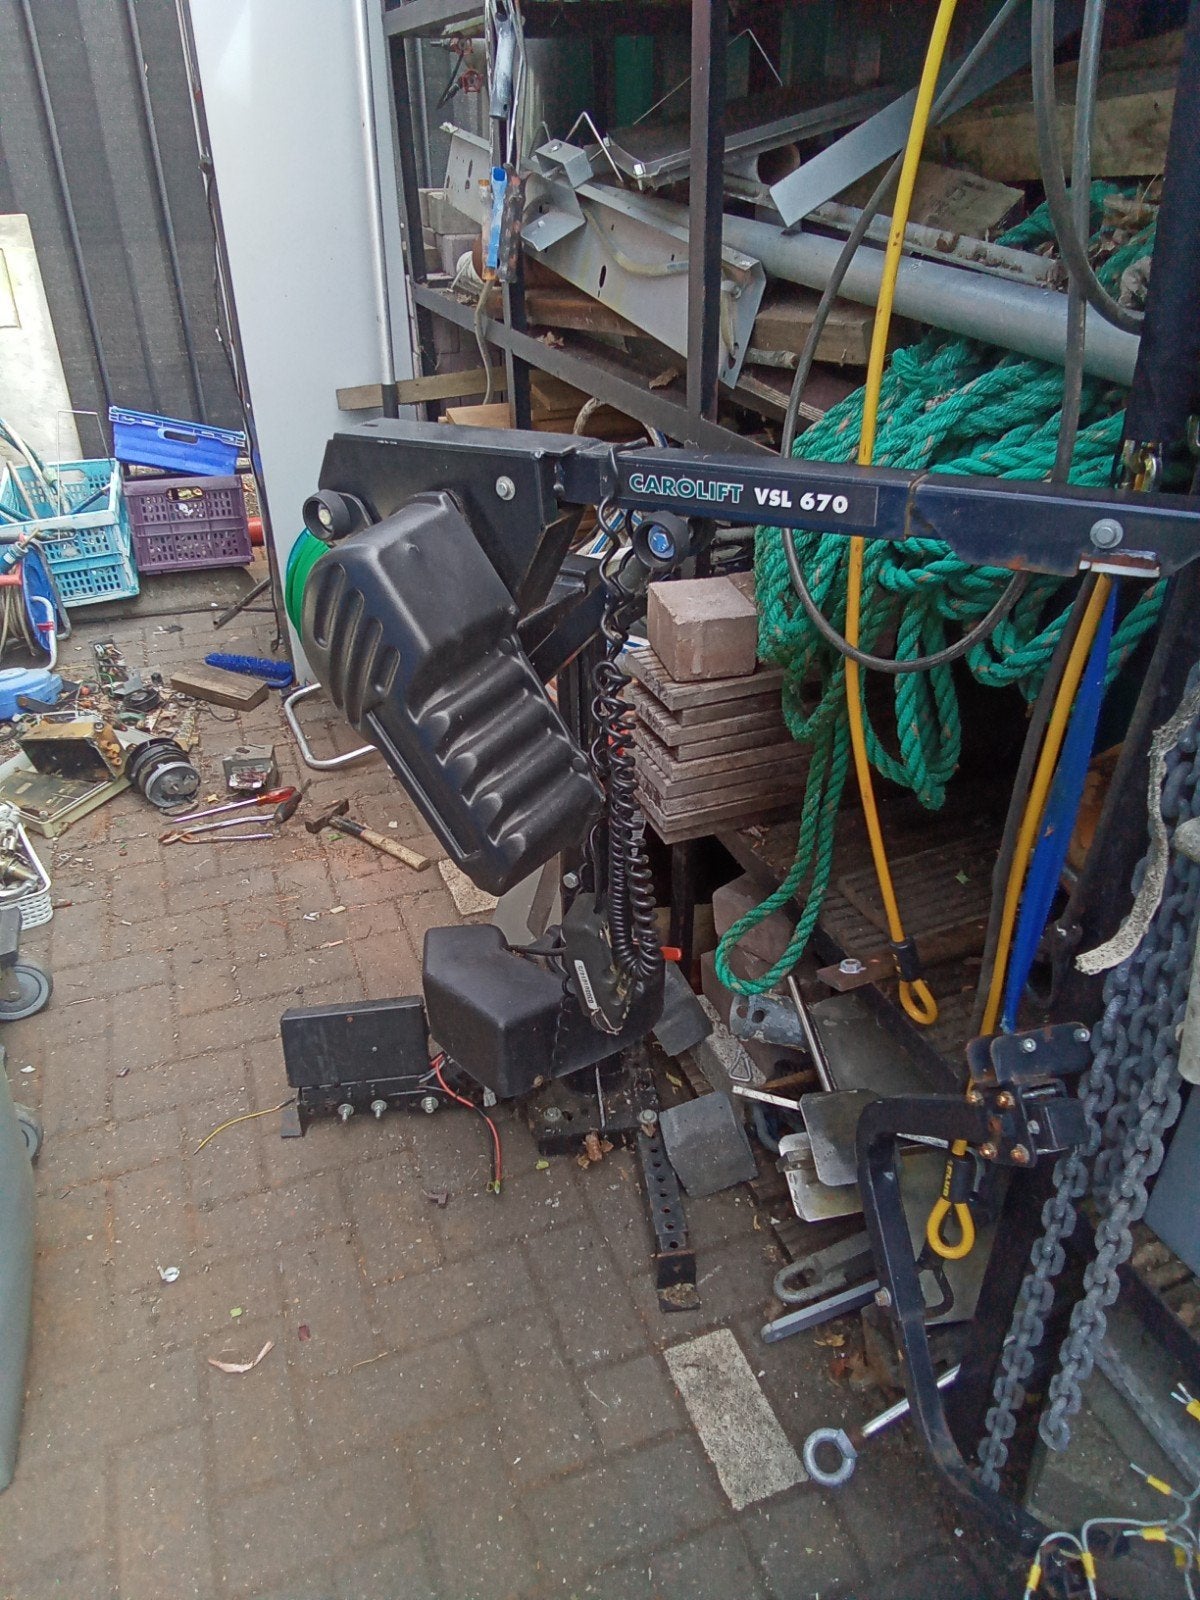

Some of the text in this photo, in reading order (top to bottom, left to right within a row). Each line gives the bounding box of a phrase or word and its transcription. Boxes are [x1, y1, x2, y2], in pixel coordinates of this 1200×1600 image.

[629, 473, 849, 514] CAROLIFT VSL 670
